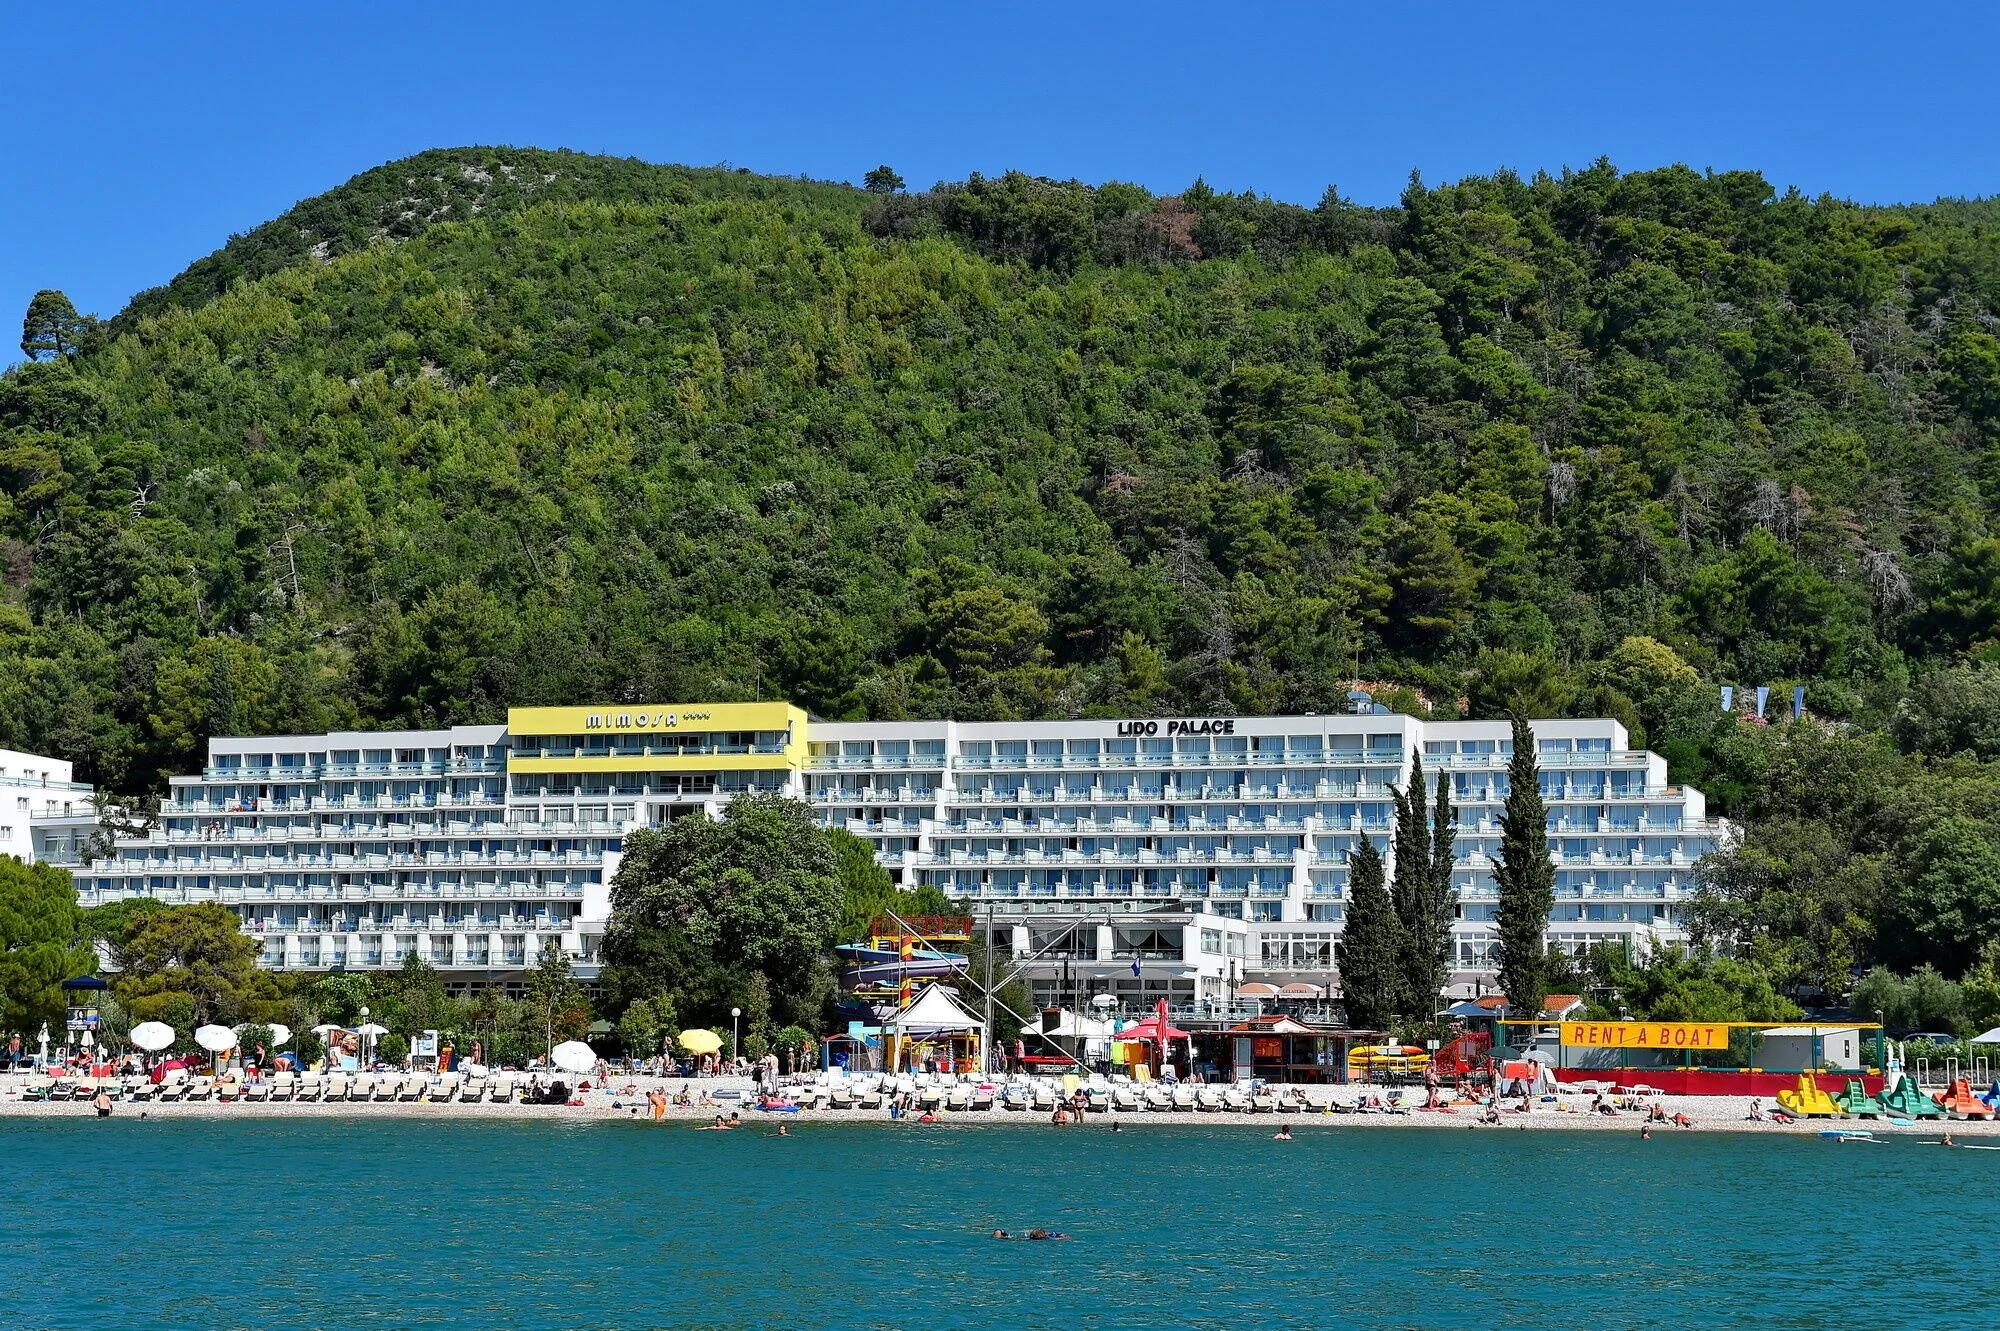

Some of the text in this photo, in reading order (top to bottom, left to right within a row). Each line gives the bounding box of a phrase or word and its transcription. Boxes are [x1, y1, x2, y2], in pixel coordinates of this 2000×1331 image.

[586, 712, 678, 729] MIMOSA
[1117, 720, 1235, 737] LIDO PALACE
[1574, 1026, 1714, 1046] RENT A BOAT
